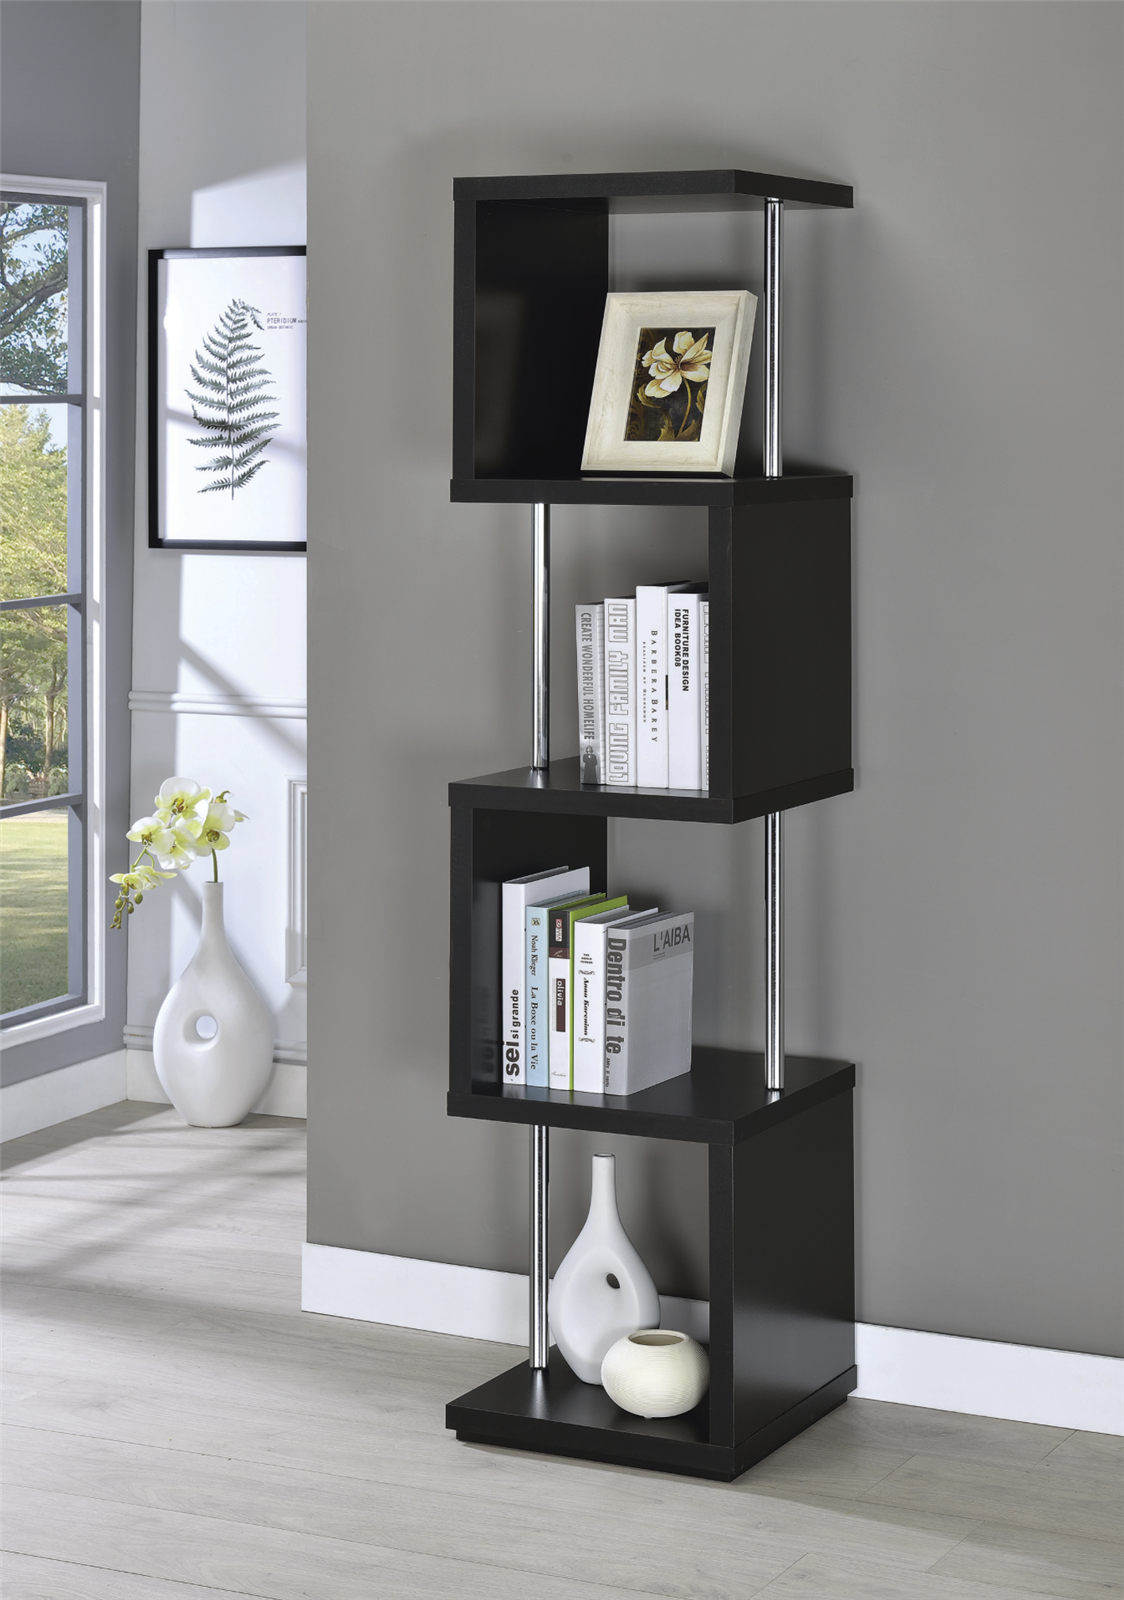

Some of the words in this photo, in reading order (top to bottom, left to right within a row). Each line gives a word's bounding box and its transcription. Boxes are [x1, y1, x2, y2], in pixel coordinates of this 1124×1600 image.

[580, 612, 592, 642] CREATE
[608, 603, 629, 643] MAN
[674, 608, 682, 629] IDEA
[682, 609, 690, 659] FURNITURE
[650, 630, 658, 693] BARBERA
[674, 632, 682, 668] BOOK08
[581, 644, 594, 695] WONDERFUL
[608, 650, 629, 716] FAMILY
[682, 659, 690, 692] DESIGN
[583, 698, 595, 740] HOMELIFE
[651, 699, 659, 742] BAREY
[608, 723, 629, 783] LOVING
[653, 924, 691, 952] L'AIBA
[529, 954, 538, 976] Klieger
[606, 937, 627, 1002] Dentro
[510, 989, 521, 1027] grande
[530, 986, 539, 999] La
[530, 1001, 539, 1026] Boxe
[606, 1009, 626, 1027] di
[510, 1029, 519, 1040] si
[530, 1028, 537, 1041] ou
[530, 1042, 538, 1053] la
[606, 1037, 626, 1055] te
[504, 1040, 520, 1077] sei
[530, 1054, 539, 1070] Vie
